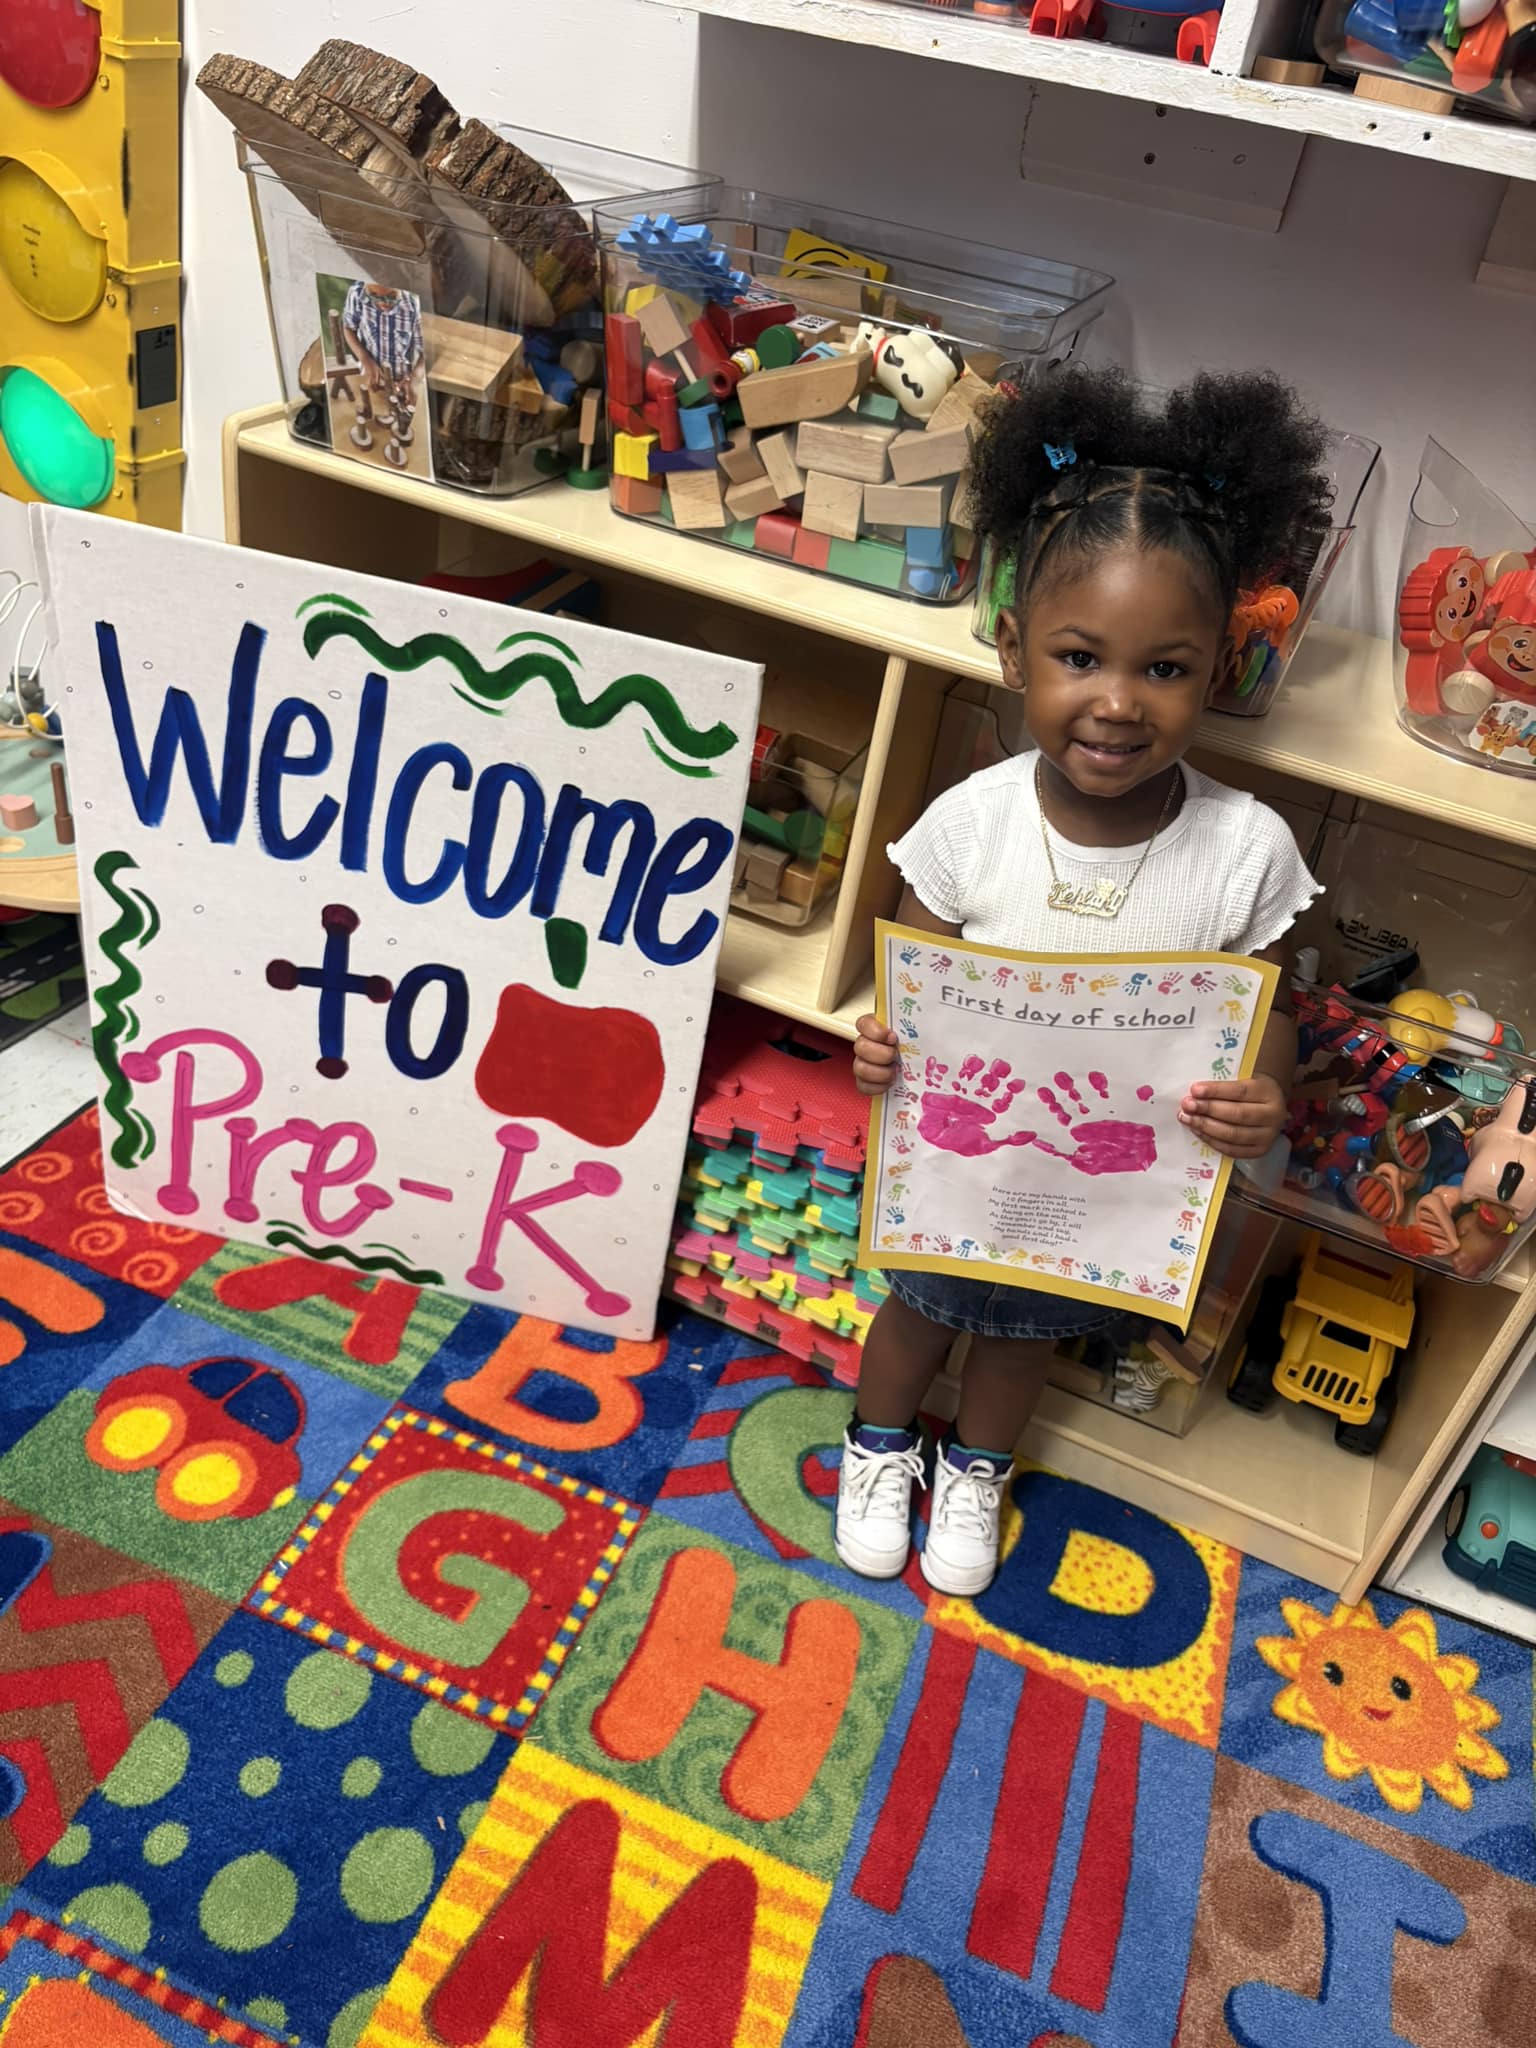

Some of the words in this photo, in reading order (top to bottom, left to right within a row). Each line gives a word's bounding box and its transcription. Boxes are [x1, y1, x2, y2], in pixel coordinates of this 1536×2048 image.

[96, 620, 736, 966] Welcome
[265, 904, 470, 1080] to
[941, 985, 1003, 1015] First
[1014, 1003, 1061, 1026] day
[1071, 1007, 1105, 1026] of
[1113, 1006, 1196, 1027] school
[121, 1028, 633, 1317] Pre-K
[1001, 1201, 1017, 1209] first
[1052, 1207, 1077, 1216] school
[1002, 1208, 1023, 1217] hang
[1017, 1197, 1045, 1205] fingers
[1028, 1192, 1041, 1200] my
[1041, 1193, 1068, 1201] hands
[1069, 1196, 1086, 1204] with
[996, 1220, 1036, 1229] remember
[1006, 1227, 1031, 1236] hands
[1021, 1235, 1038, 1243] first
[443, 1313, 669, 1452] B
[340, 1468, 568, 1668] G
[972, 1470, 1212, 1671] D
[591, 1547, 862, 1822] H
[423, 1798, 758, 2048] M
